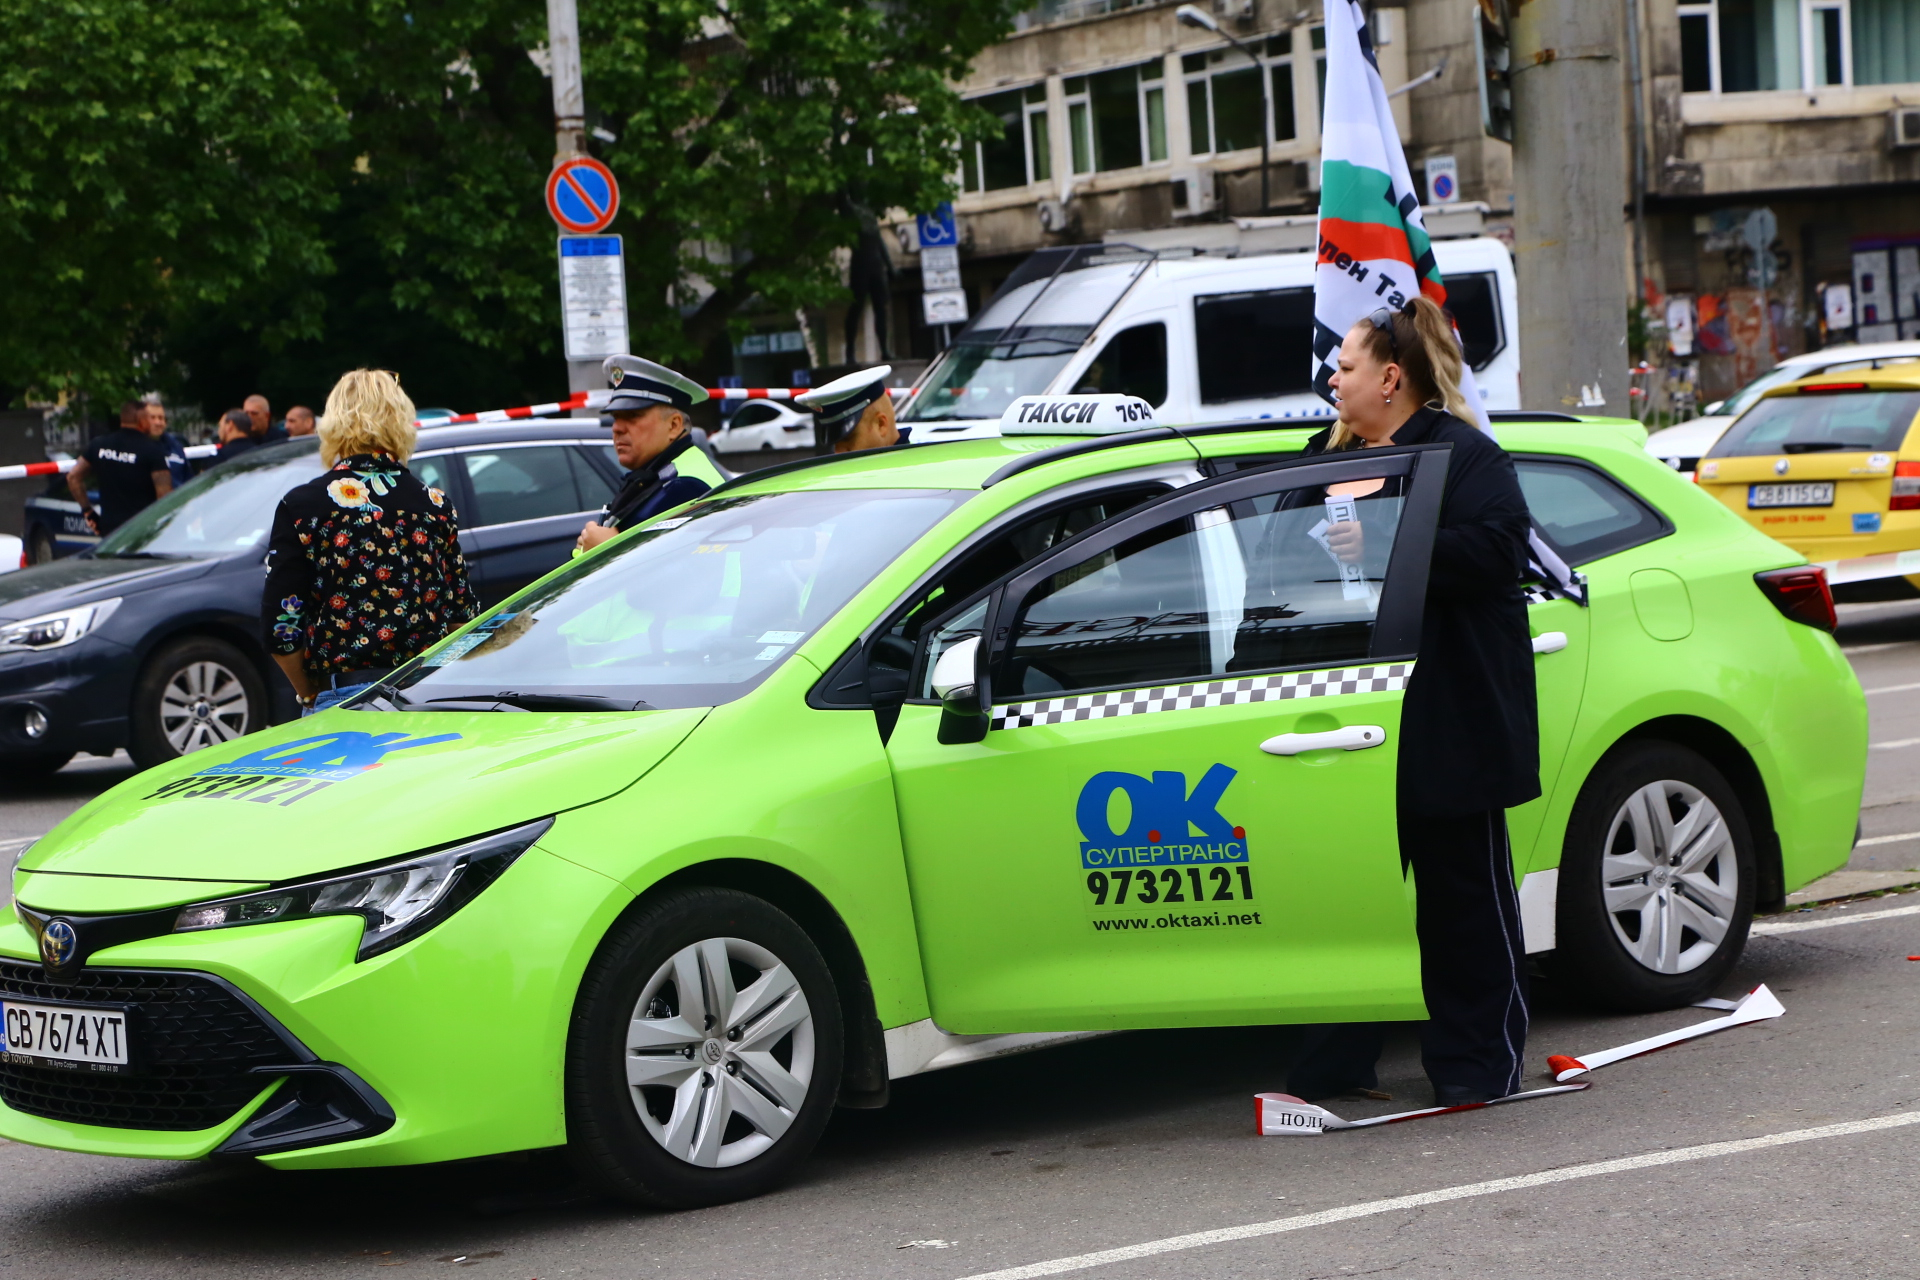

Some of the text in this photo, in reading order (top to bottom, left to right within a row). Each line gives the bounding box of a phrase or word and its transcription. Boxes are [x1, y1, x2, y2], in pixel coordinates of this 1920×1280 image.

[1375, 272, 1406, 310] Та
[1018, 402, 1153, 423] ТАКСИ 7674
[98, 448, 136, 463] POLICE
[202, 765, 353, 780] СУПЕРТРАНС
[140, 774, 336, 807] 9732121
[1086, 843, 1242, 865] СУПЕРТРАНС
[1087, 866, 1253, 905] 9732121
[1093, 911, 1262, 931] www.oktaxi.net
[11, 1054, 34, 1065] TOYOTA
